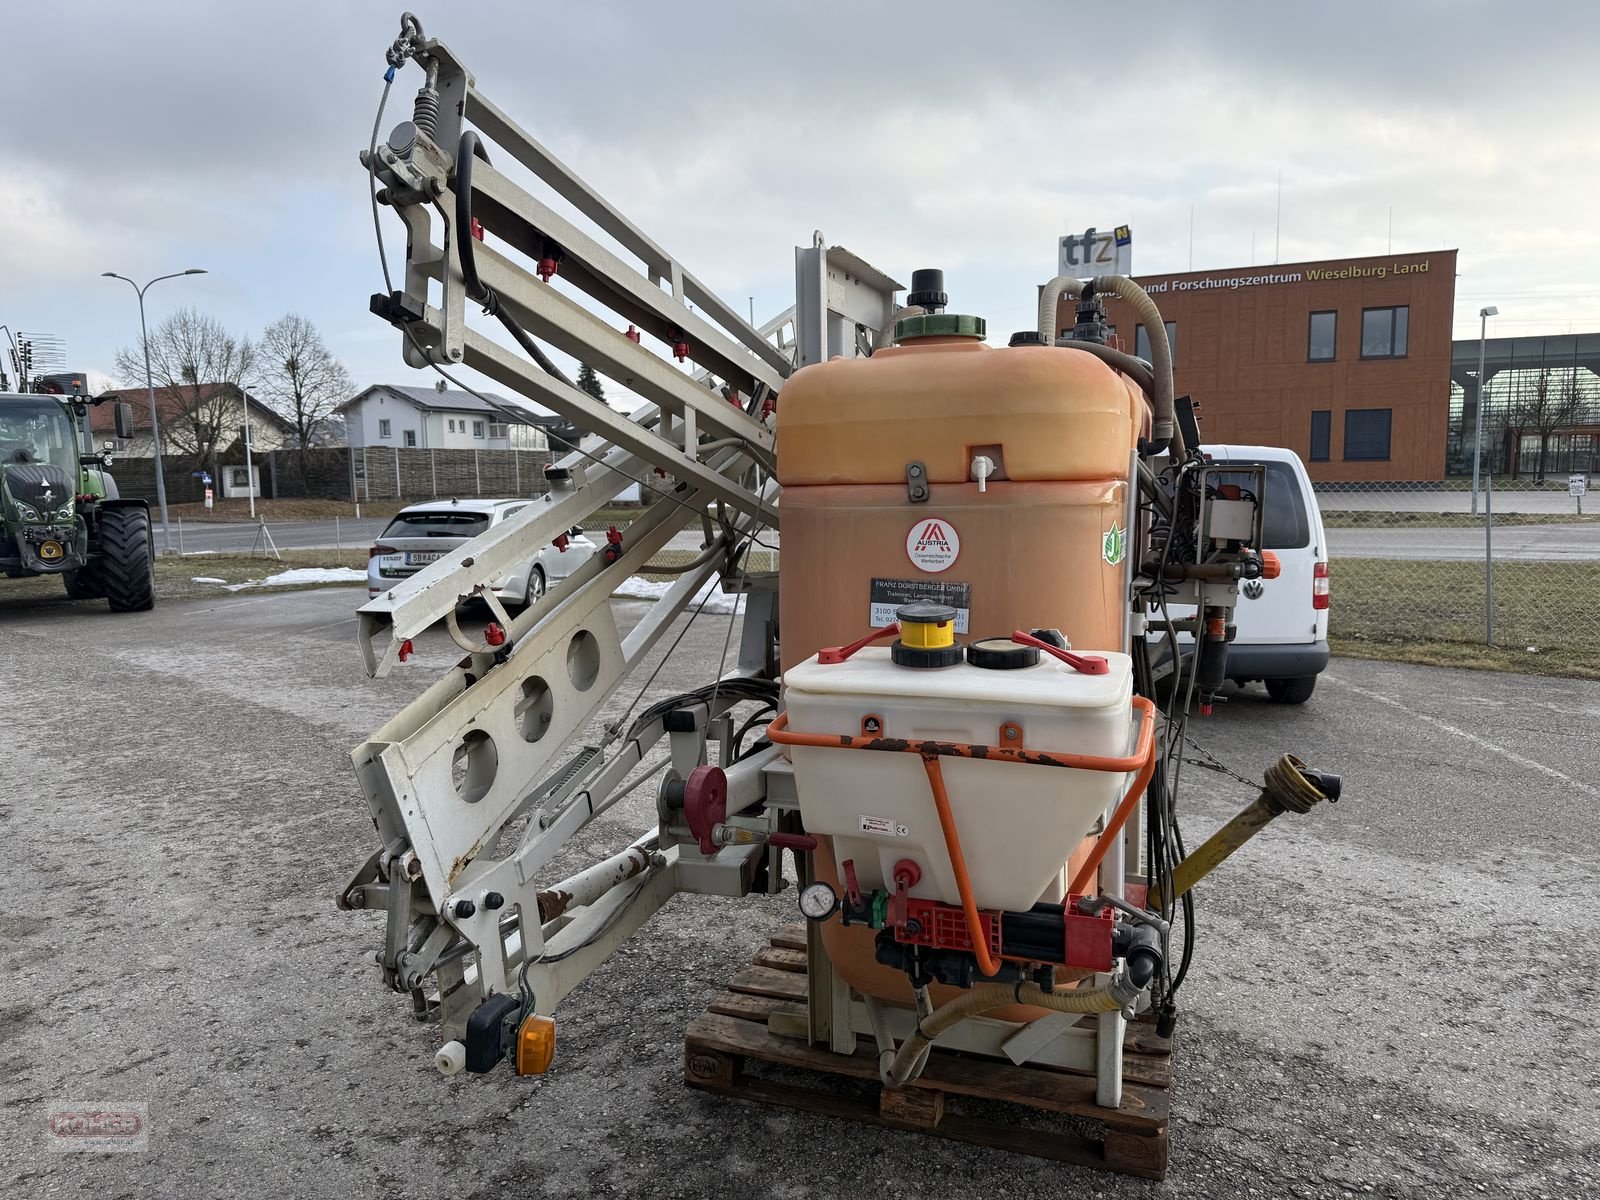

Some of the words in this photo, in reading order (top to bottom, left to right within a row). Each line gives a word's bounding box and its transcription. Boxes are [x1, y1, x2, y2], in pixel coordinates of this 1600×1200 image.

[1062, 227, 1113, 266] tfz
[1143, 281, 1168, 294] und
[1172, 272, 1301, 292] Forschungszentrum
[1306, 260, 1429, 281] Wieselburg-Land
